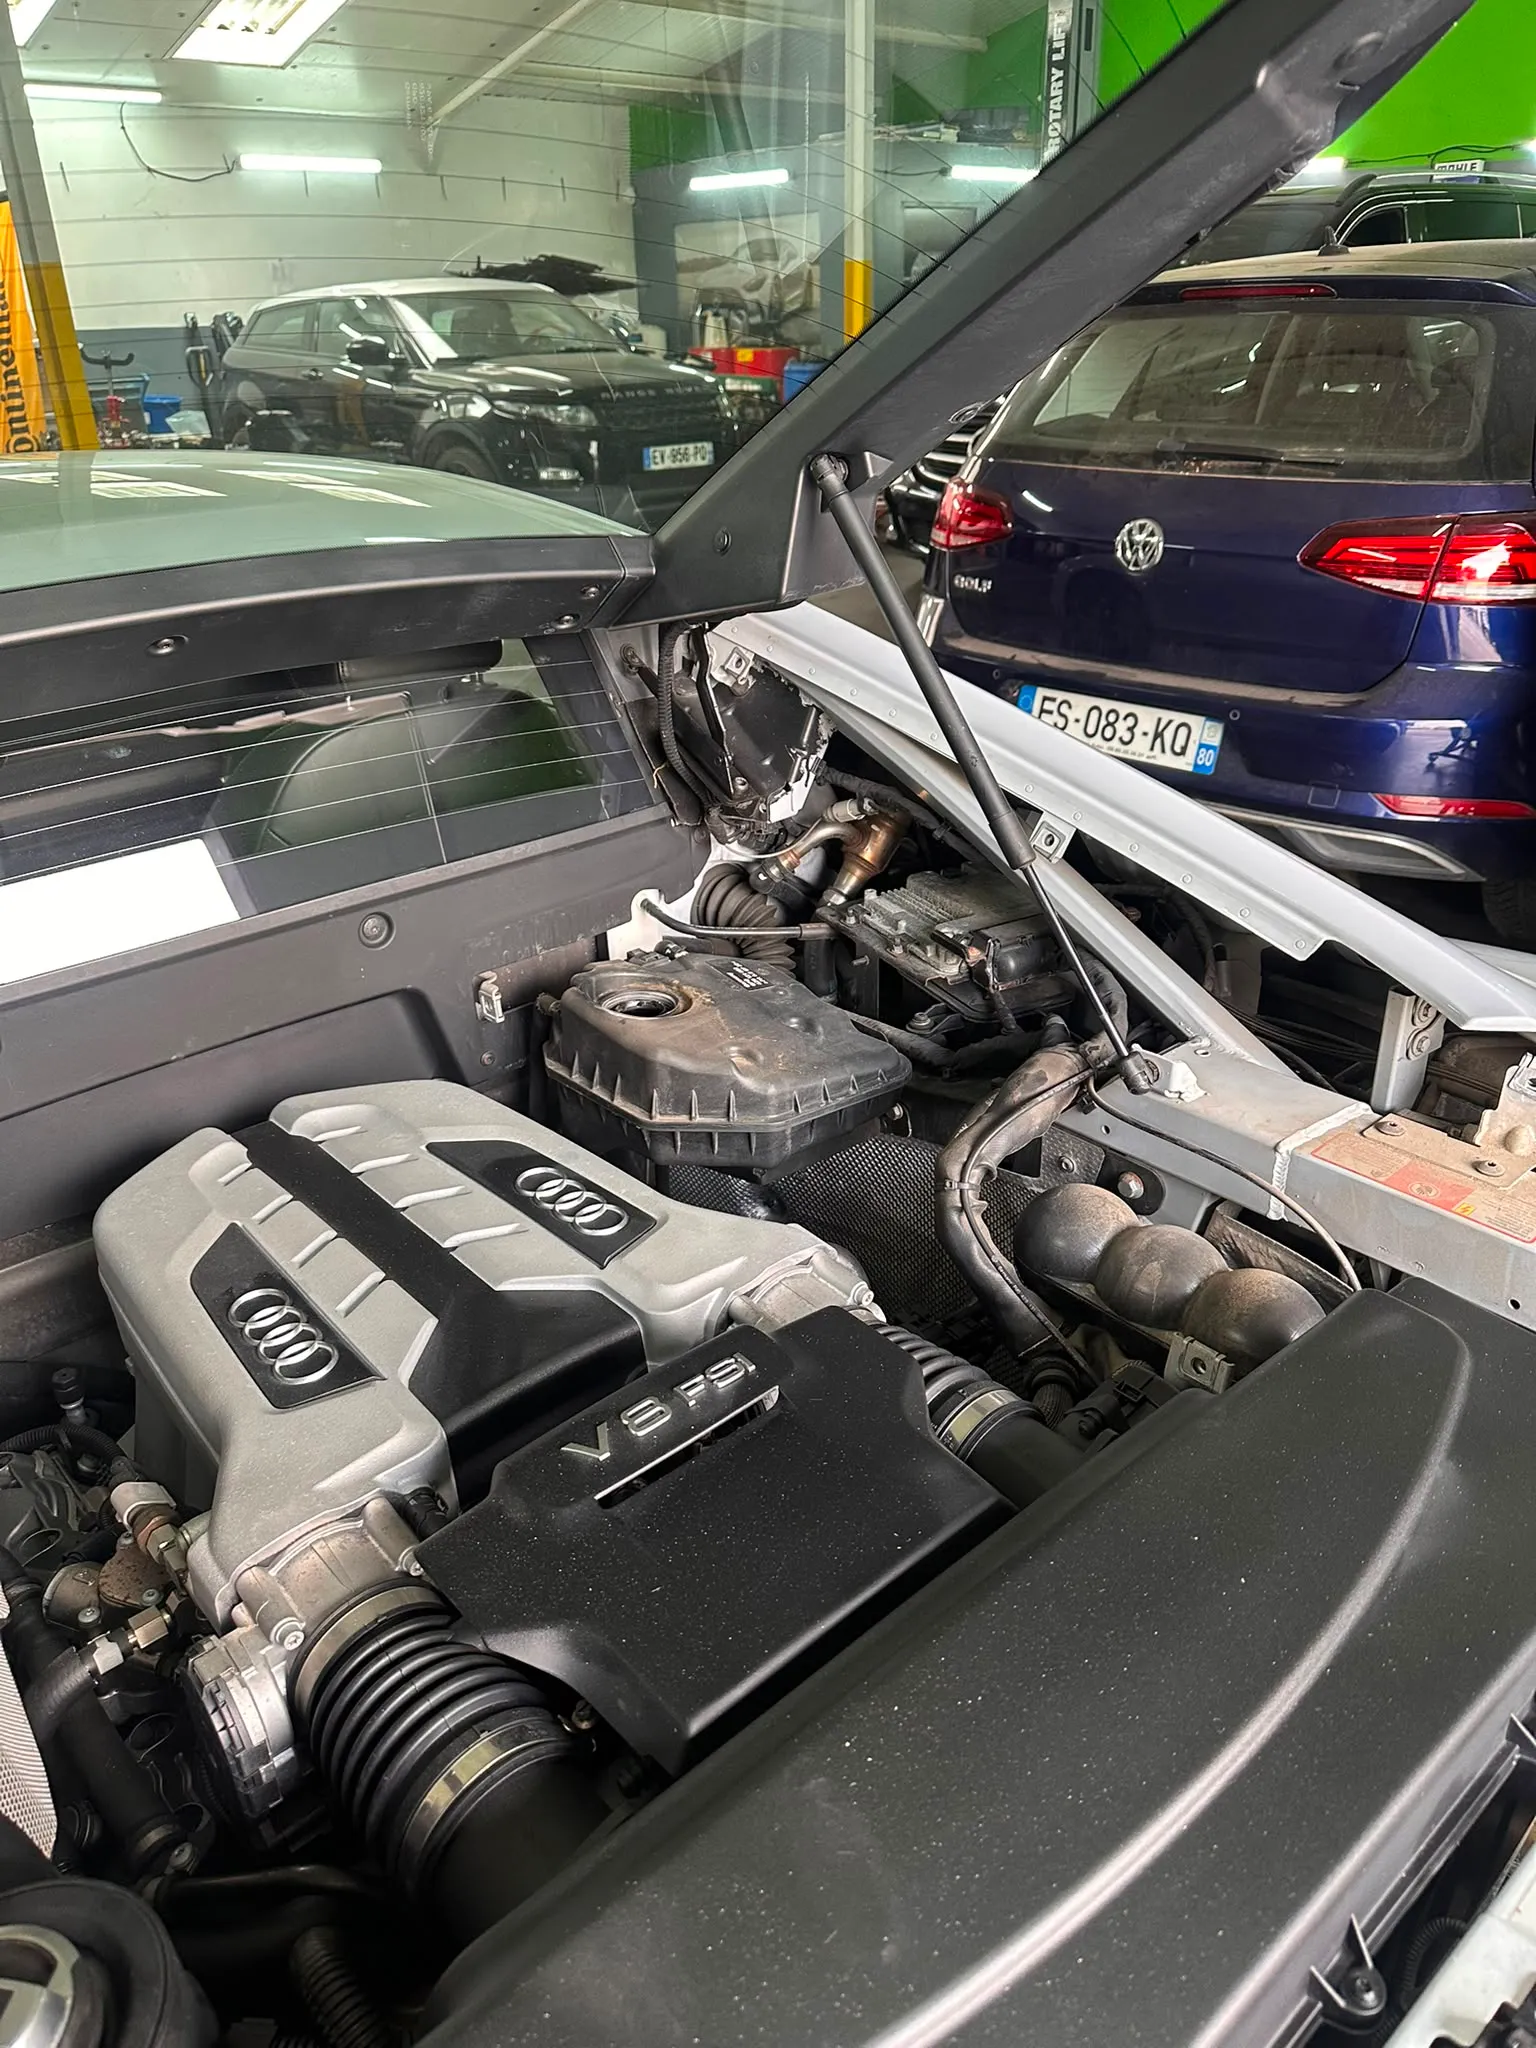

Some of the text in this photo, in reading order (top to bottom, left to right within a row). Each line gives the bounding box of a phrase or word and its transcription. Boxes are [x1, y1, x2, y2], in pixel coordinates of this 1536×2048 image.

[1047, 14, 1069, 150] ROTARY LIFT
[1197, 747, 1215, 767] 80
[673, 1352, 756, 1407] FSI
